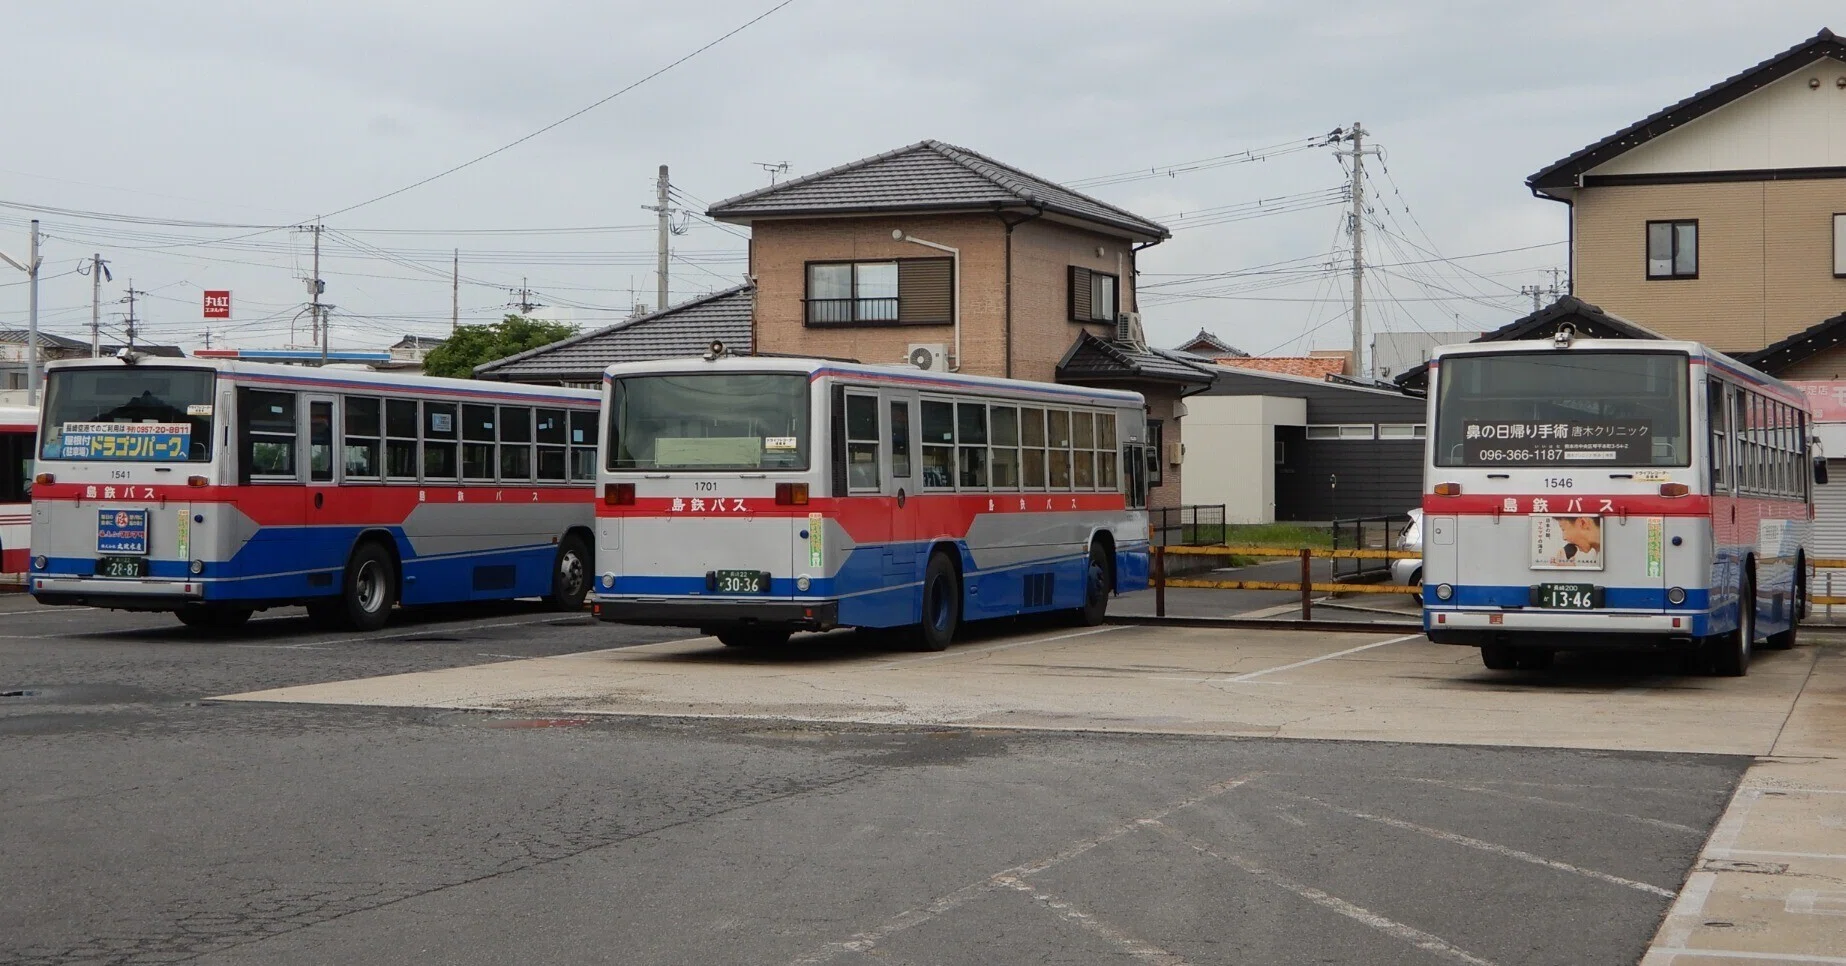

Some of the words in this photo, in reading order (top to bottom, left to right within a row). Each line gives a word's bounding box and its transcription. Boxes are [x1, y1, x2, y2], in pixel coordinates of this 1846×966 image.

[205, 296, 228, 306] 丸紅
[66, 424, 124, 433] 長崎空港でのご利用は
[136, 426, 189, 434] 0957-20-8811
[1466, 424, 1569, 439] 鼻の日帰り手術
[1571, 425, 1649, 437] 唐木クリニック
[64, 436, 91, 446] 屋根付
[1479, 449, 1563, 461] 096-366-1187
[111, 470, 130, 479] 1541
[694, 482, 717, 491] 1701
[1544, 478, 1573, 488] 1546
[86, 485, 155, 498] 島鉄バス
[671, 498, 747, 512] 島鉄バス
[1503, 497, 1614, 512] 島鉄バス
[111, 563, 139, 576] 28-87
[725, 577, 759, 592] 30-36
[1552, 591, 1592, 607] 13-46
